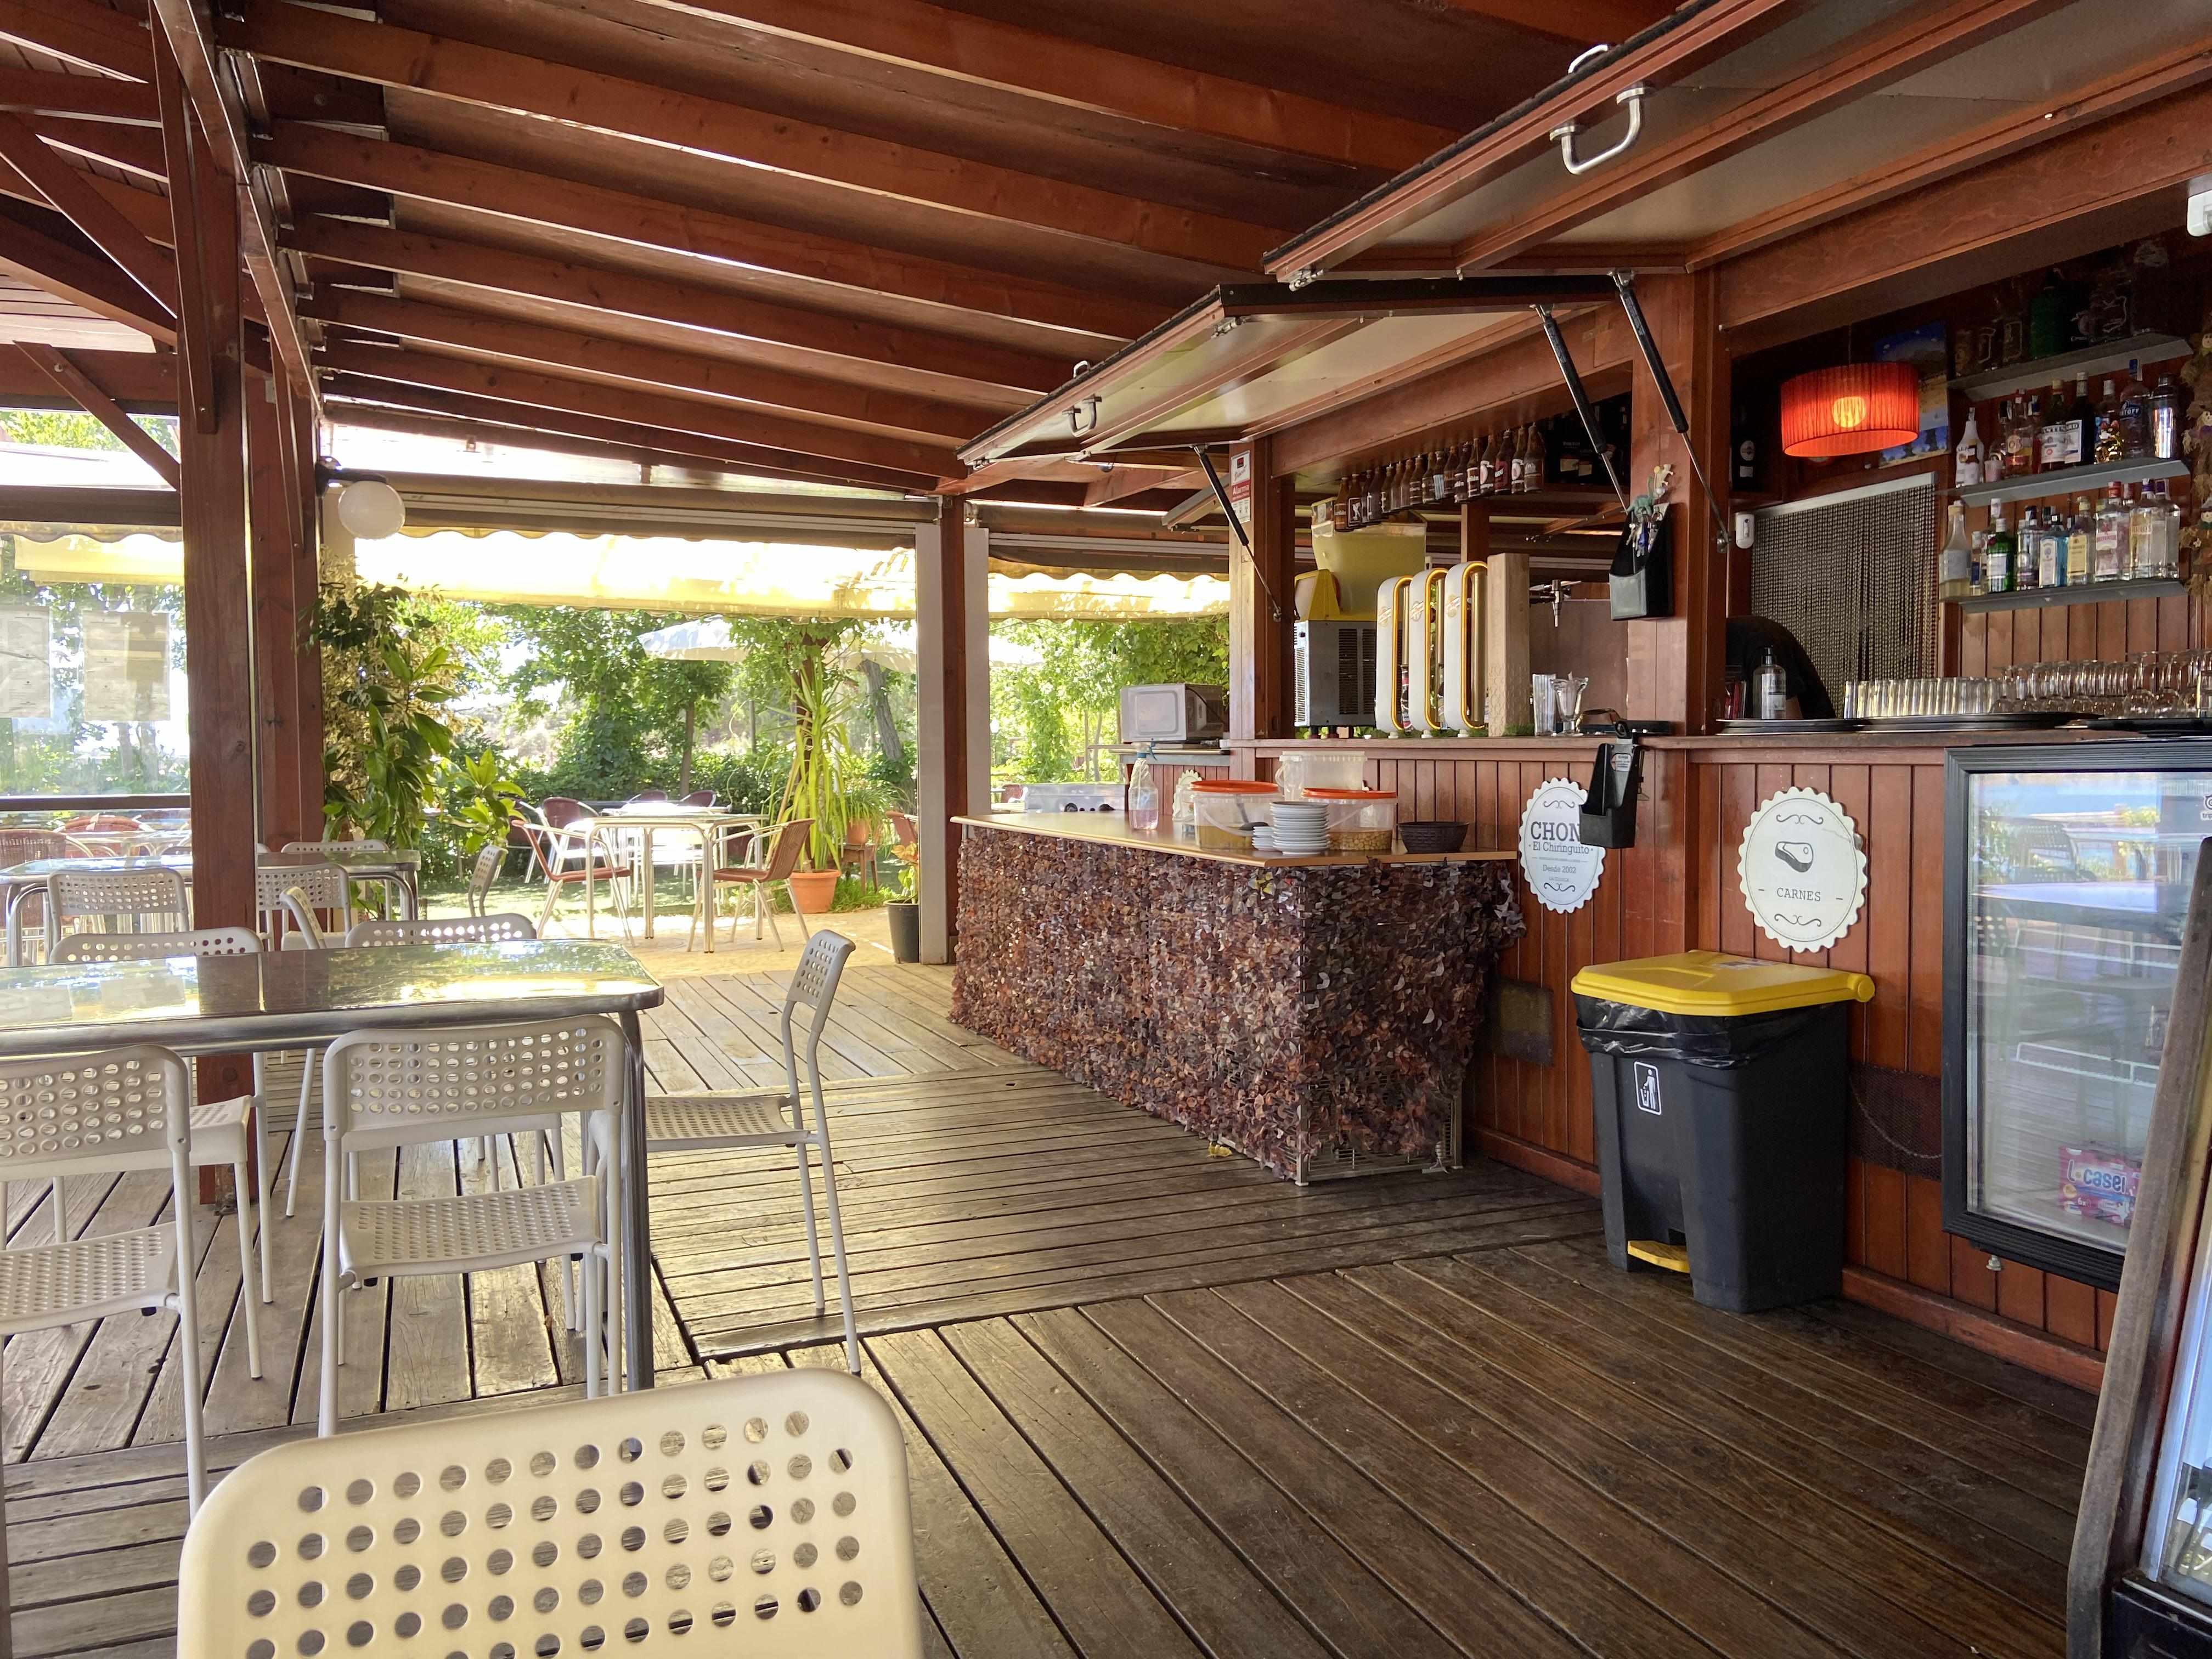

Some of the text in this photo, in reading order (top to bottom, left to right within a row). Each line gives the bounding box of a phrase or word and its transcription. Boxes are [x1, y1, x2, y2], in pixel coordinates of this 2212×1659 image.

[1533, 842, 1590, 855] El Chiringuito
[1543, 864, 1576, 874] Desde 2002
[1776, 887, 1821, 902] CARNES
